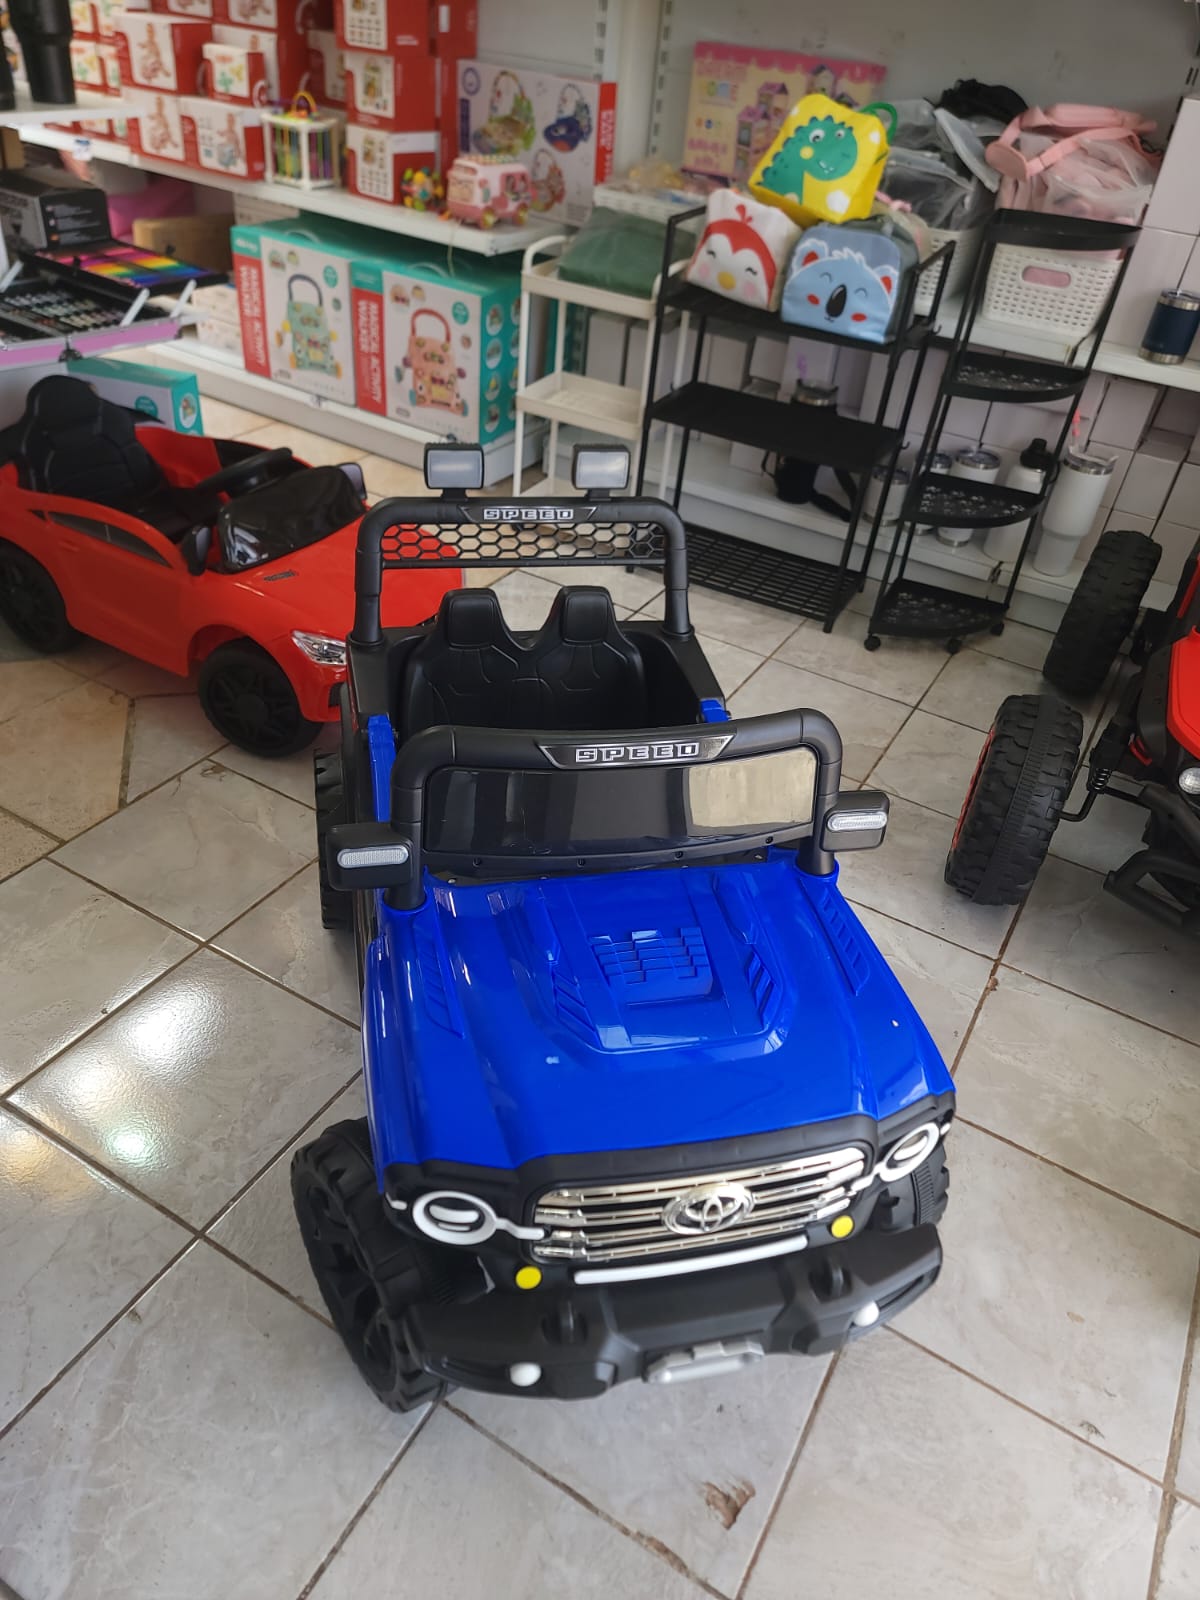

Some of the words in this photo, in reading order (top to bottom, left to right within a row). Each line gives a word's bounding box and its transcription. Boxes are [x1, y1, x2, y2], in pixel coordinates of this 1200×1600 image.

[239, 264, 254, 316] WALKER
[254, 319, 267, 367] ACTIVITY
[358, 299, 369, 352] WALKER
[370, 355, 382, 403] ACTIVITY
[483, 508, 574, 521] SPEED
[575, 742, 700, 763] SPEED
